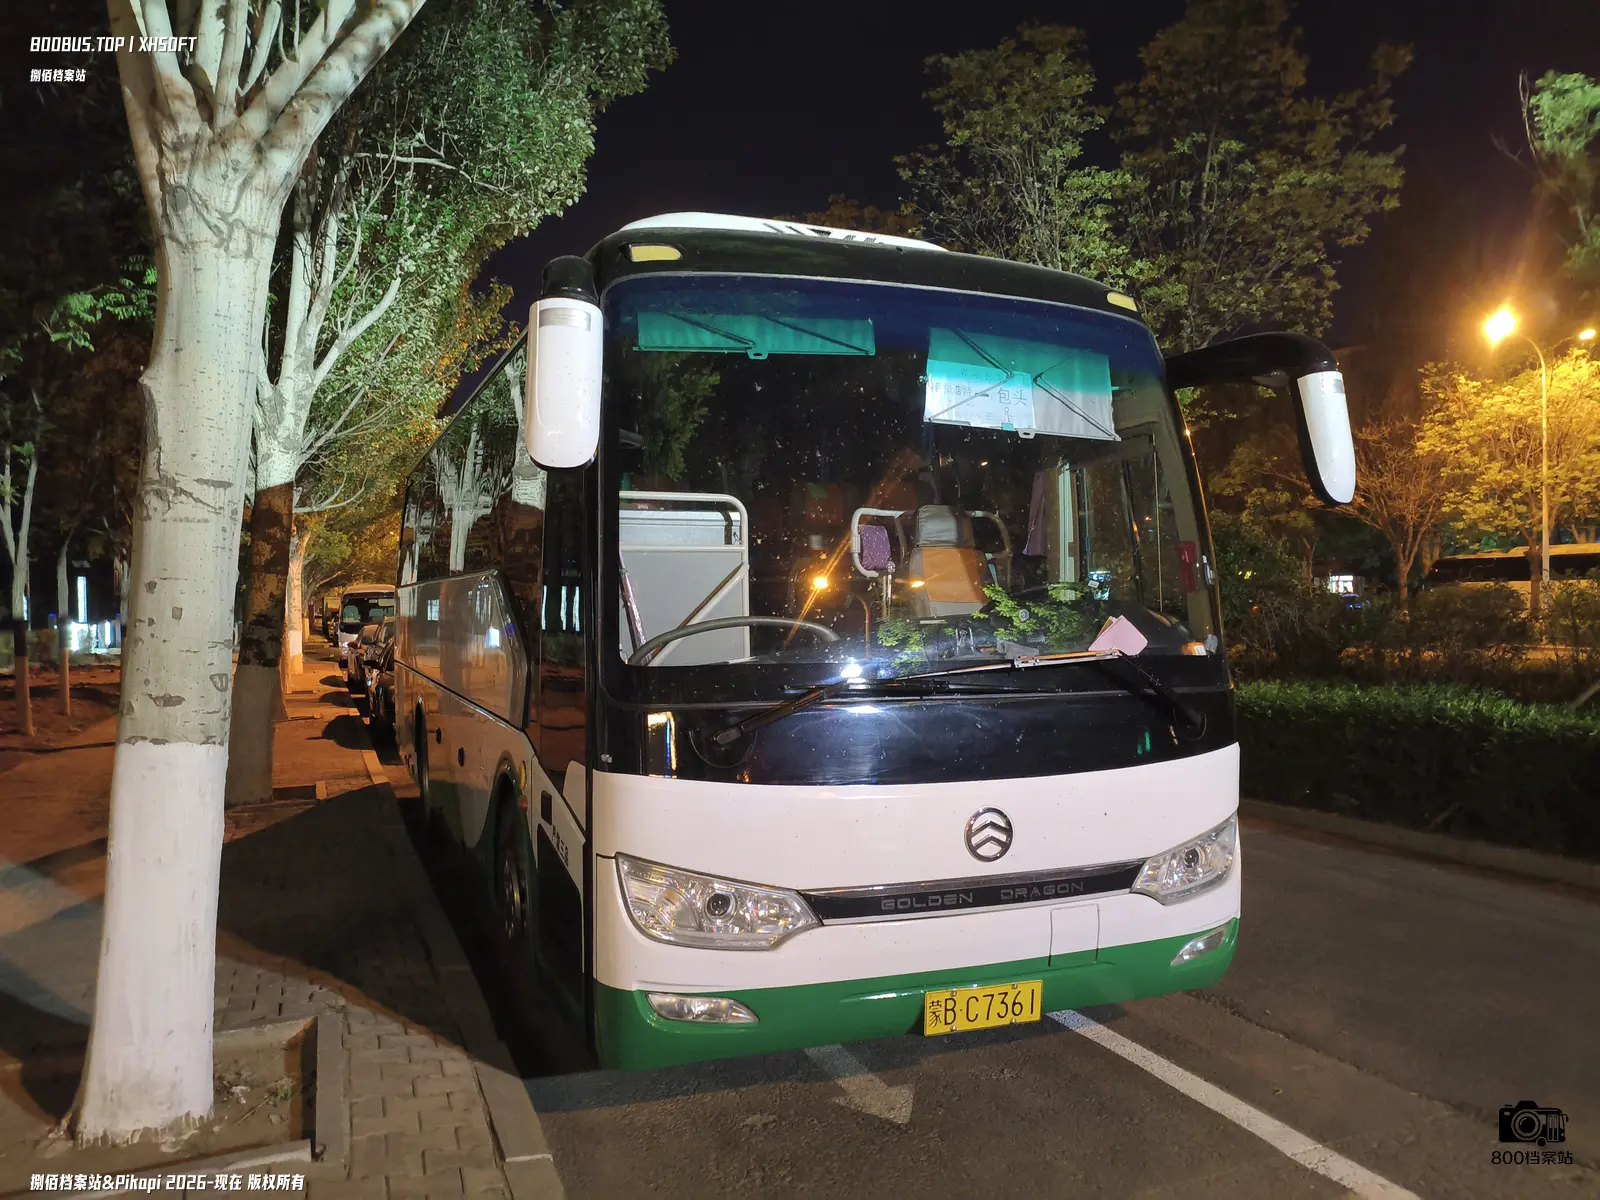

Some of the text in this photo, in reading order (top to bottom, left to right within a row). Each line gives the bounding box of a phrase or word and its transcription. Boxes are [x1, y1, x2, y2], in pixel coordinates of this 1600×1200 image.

[997, 387, 1027, 407] 包头
[880, 881, 1085, 911] GOLDEN DRAGON
